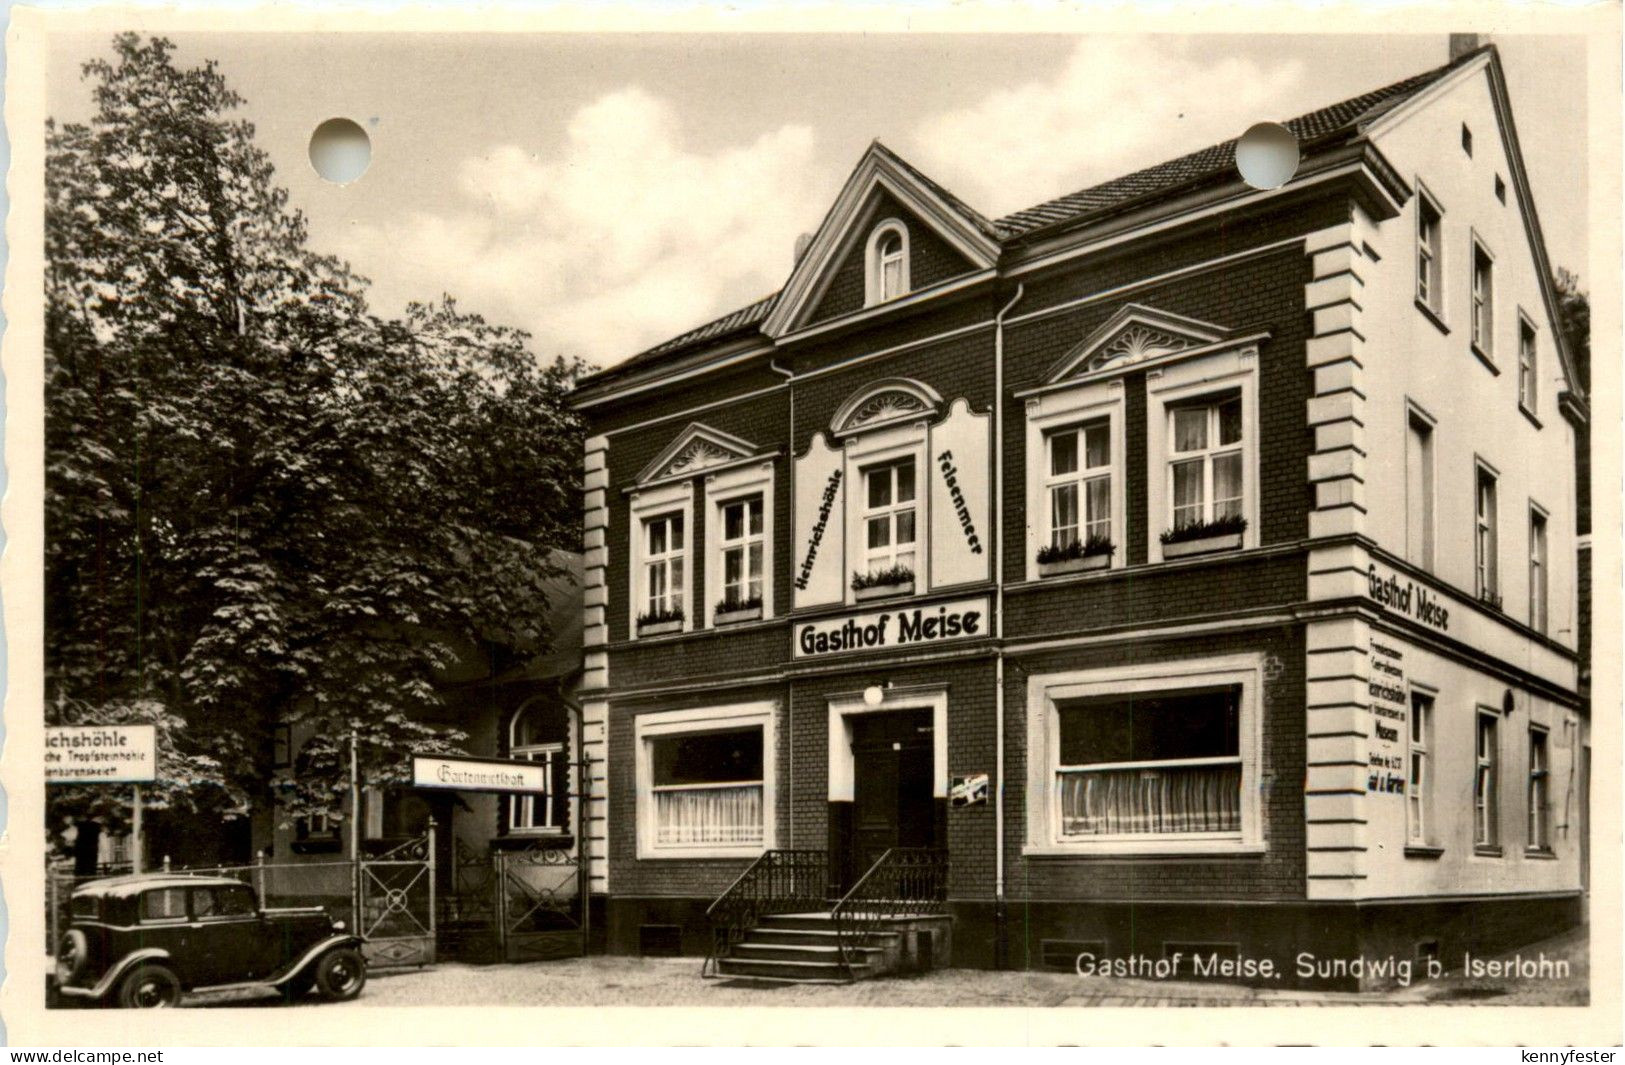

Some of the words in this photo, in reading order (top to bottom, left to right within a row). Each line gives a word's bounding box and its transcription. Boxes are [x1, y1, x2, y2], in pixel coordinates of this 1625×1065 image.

[794, 469, 843, 590] Heinrichshöhle
[937, 450, 983, 555] Felsenmeer
[800, 614, 891, 655] Gasthof
[898, 606, 981, 644] Meise
[1368, 563, 1413, 616] Gasthof
[1416, 586, 1449, 632] Meise
